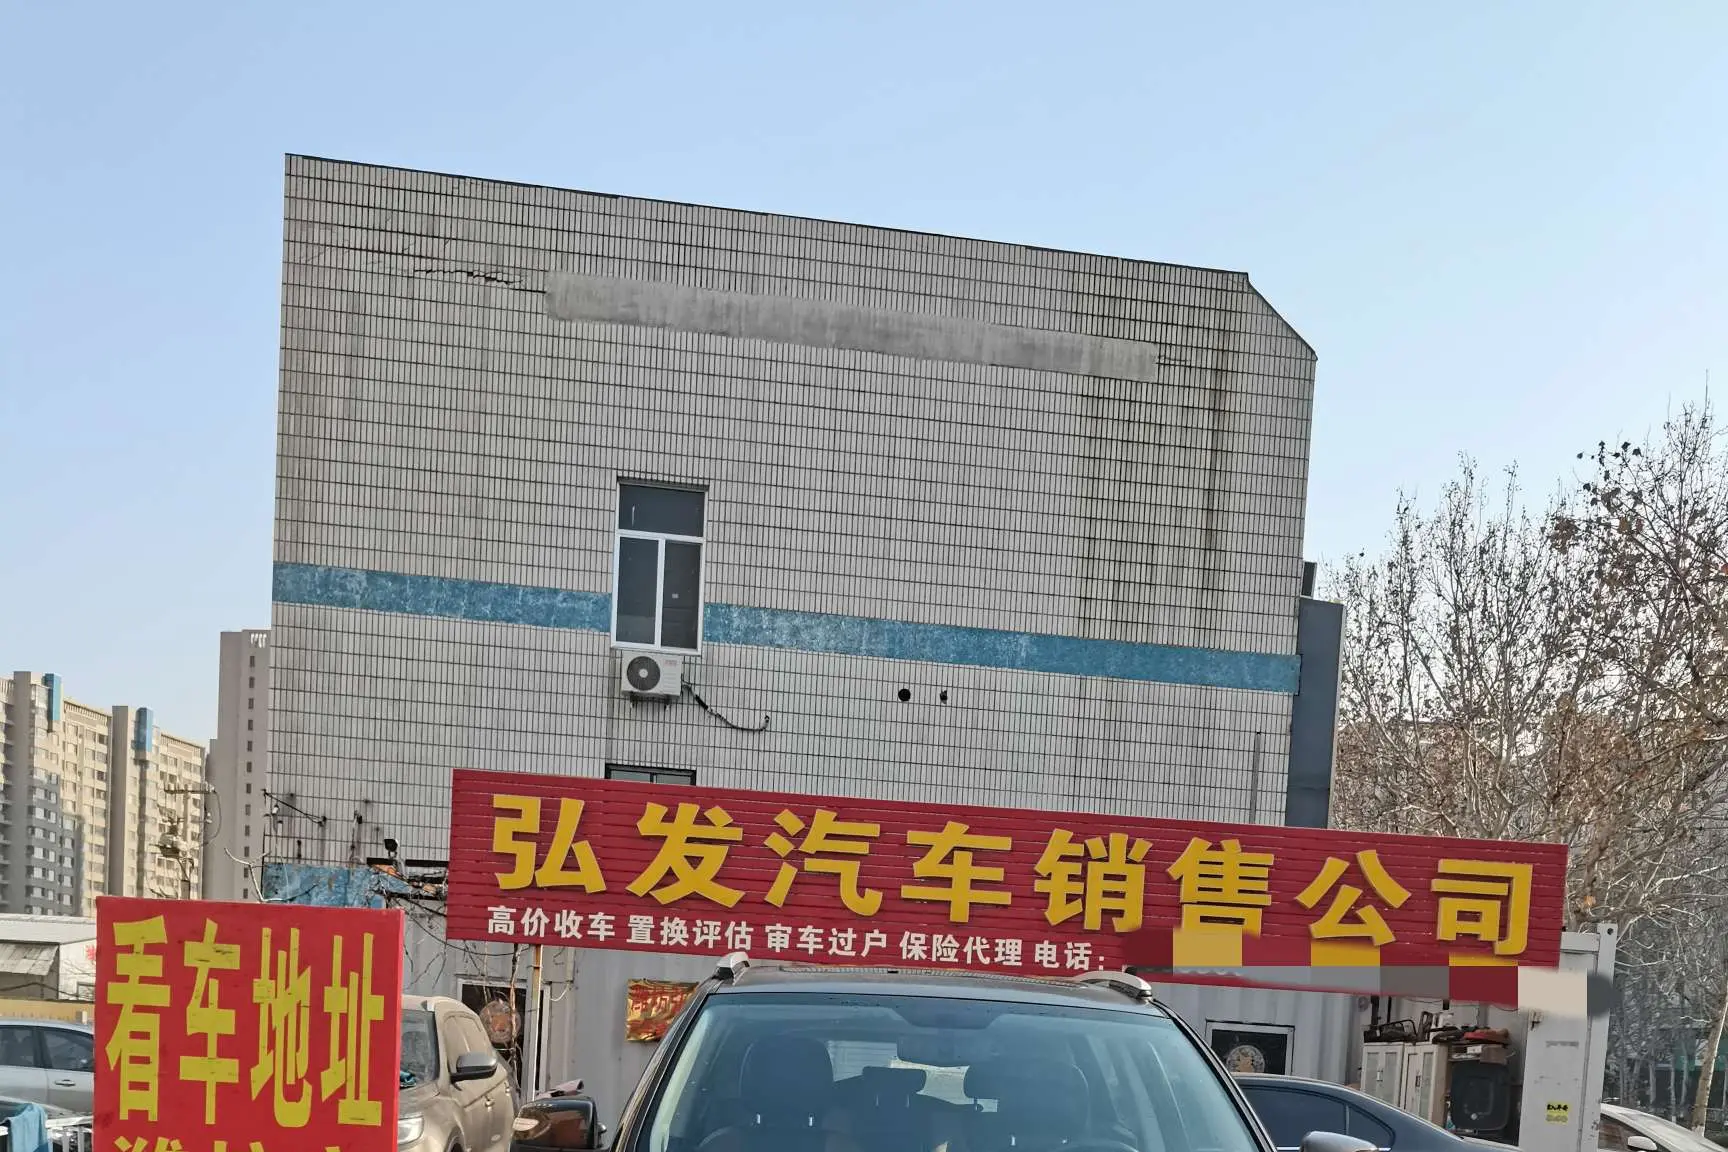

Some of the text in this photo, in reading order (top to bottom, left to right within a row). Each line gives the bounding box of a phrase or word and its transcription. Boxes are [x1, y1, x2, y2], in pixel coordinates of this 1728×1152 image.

[486, 906, 616, 942] 高价收车
[626, 915, 754, 951] 置换评估
[765, 923, 887, 958] 审车过户
[899, 931, 1022, 966] 保险代理
[493, 795, 1532, 955] 弘发汽车销售公司
[106, 914, 385, 1128] 看车地址
